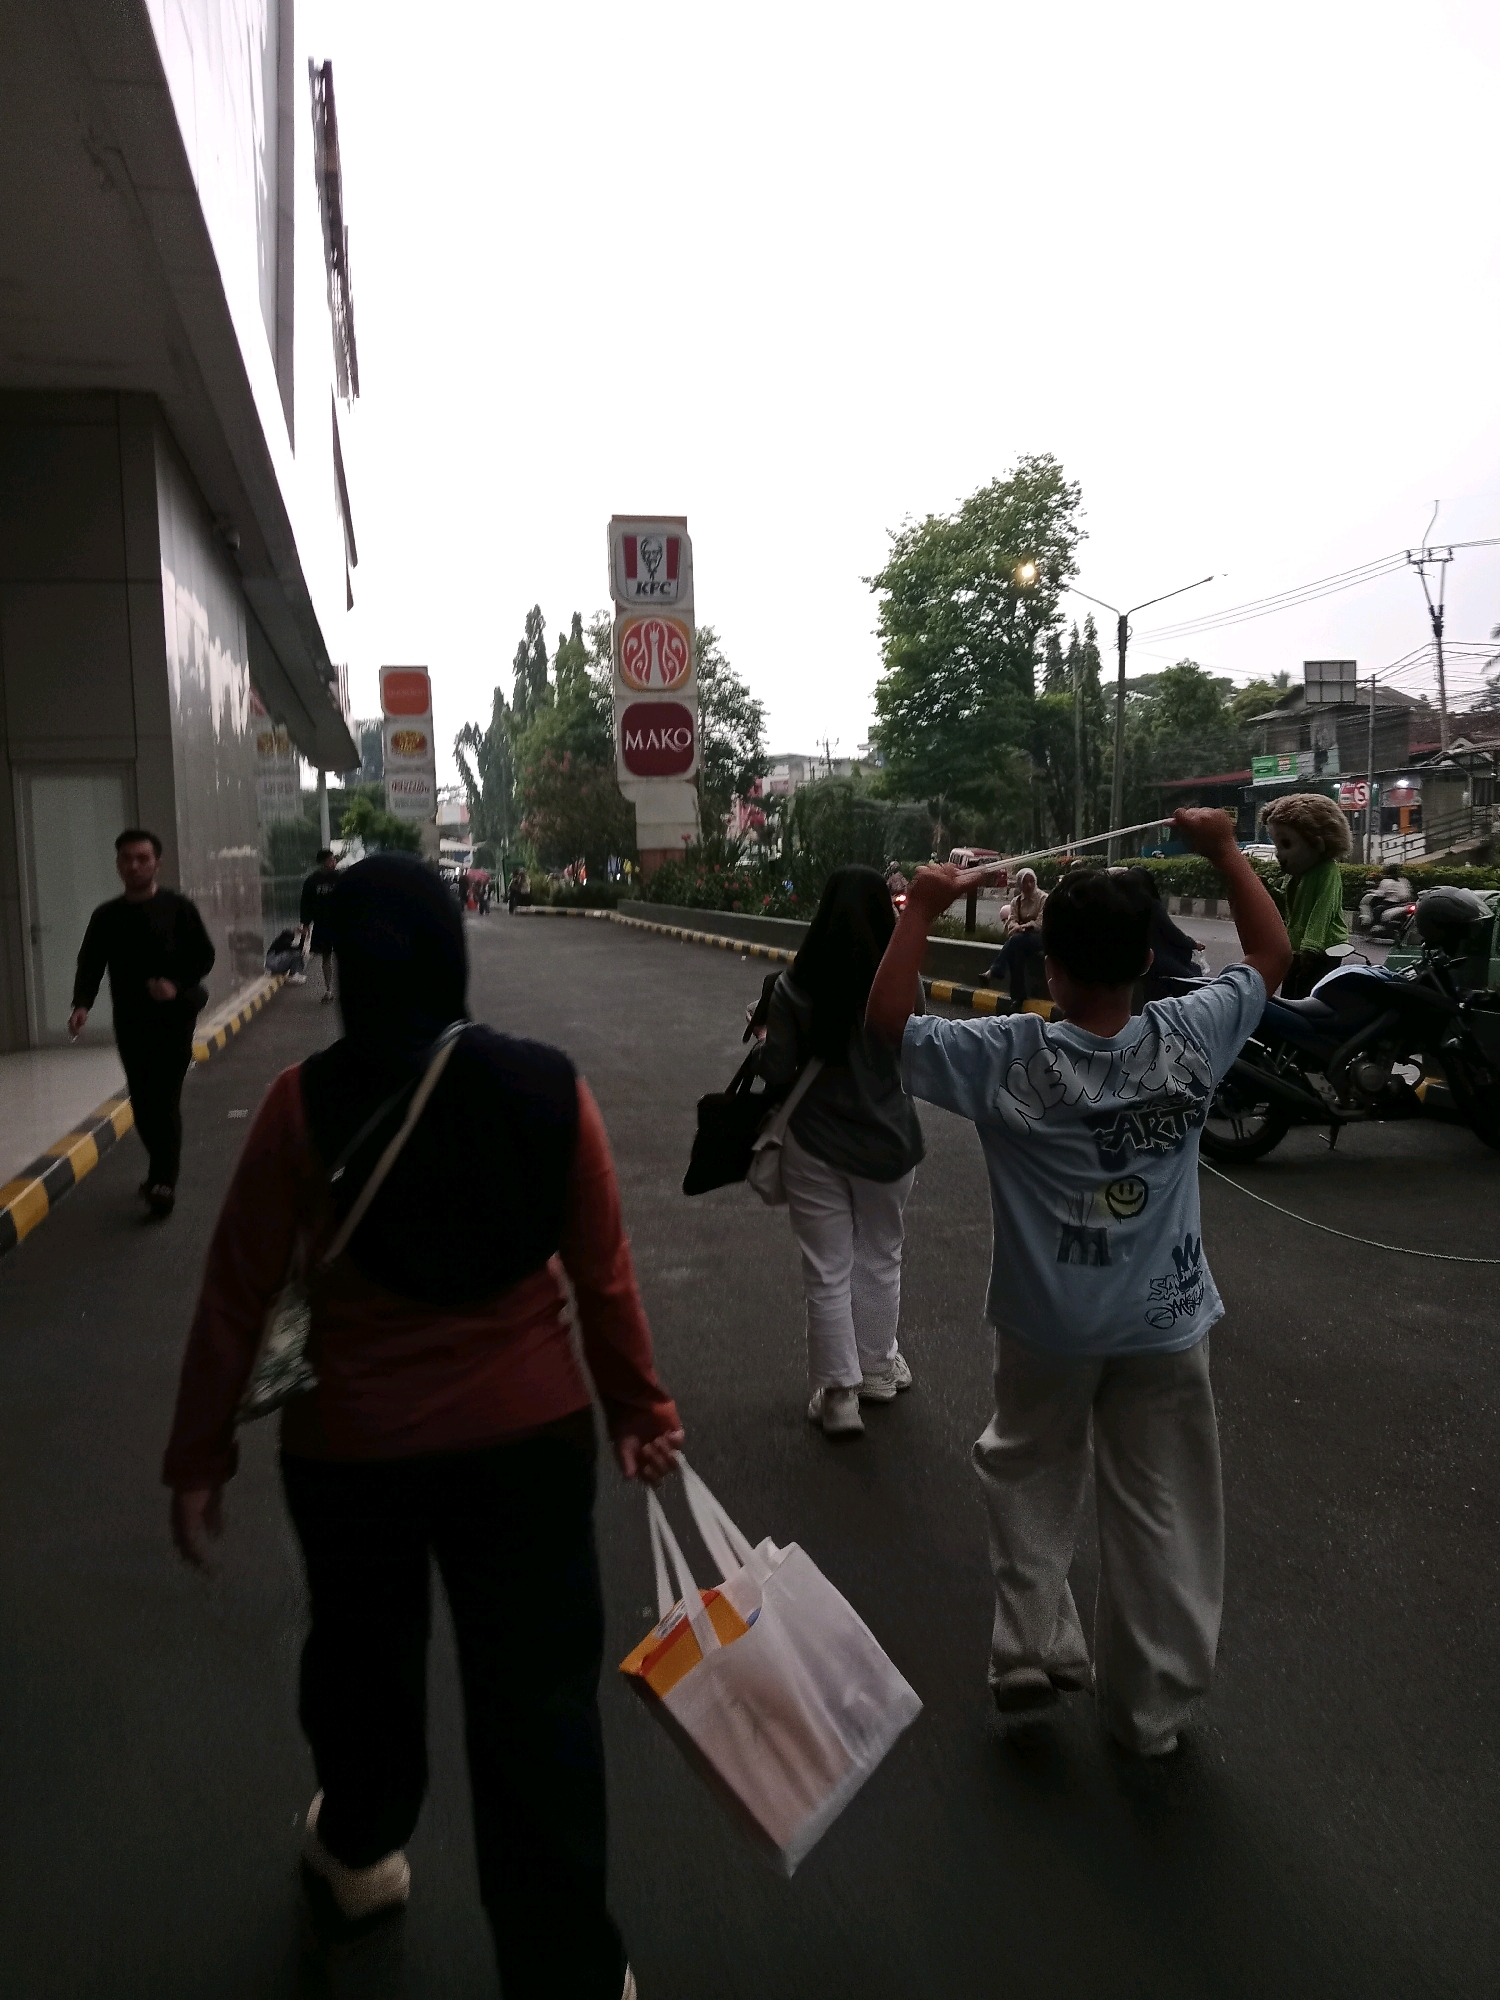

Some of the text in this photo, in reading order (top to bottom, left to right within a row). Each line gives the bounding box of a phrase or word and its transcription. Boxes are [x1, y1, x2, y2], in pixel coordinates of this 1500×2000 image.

[636, 581, 671, 595] KFC
[625, 727, 692, 752] MAKO
[993, 1046, 1114, 1135] NEW
